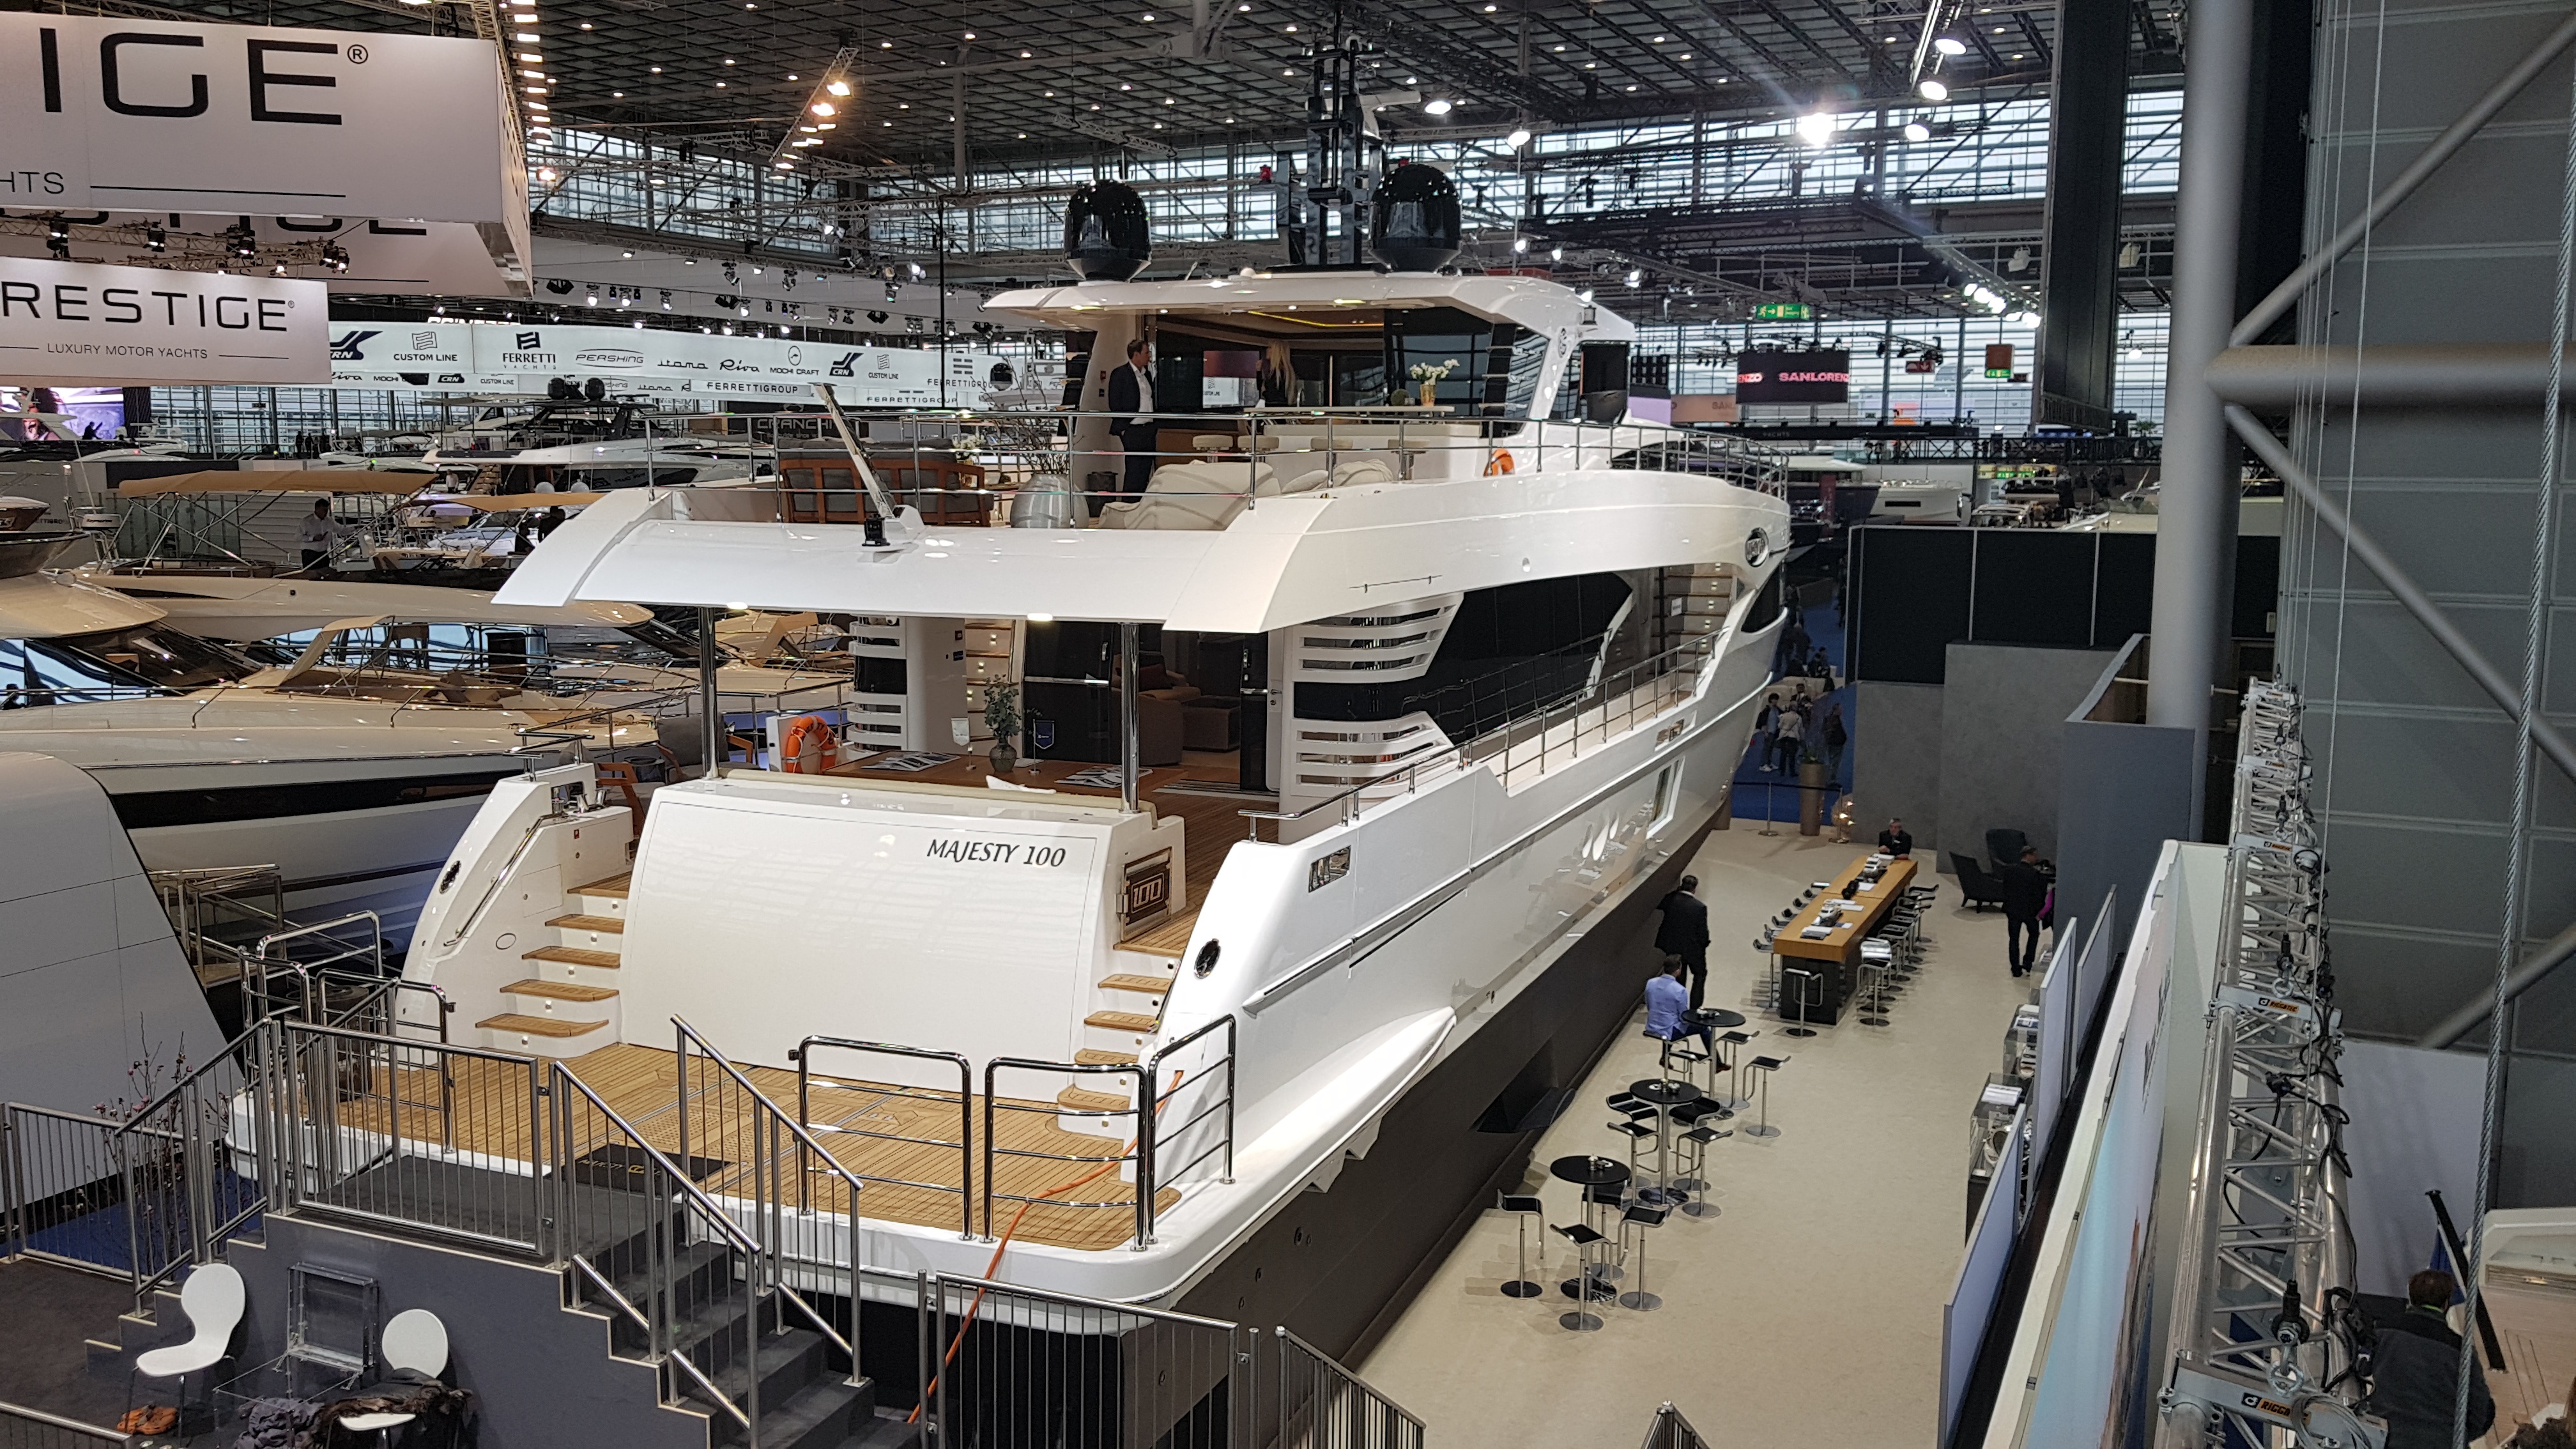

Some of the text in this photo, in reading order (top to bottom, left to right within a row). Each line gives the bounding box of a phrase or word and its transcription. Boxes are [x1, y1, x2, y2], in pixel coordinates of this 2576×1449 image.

[1, 280, 288, 332] RESTIGE
[47, 343, 208, 358] LUXURY MOTOR YACHTS
[330, 351, 354, 359] RN
[503, 353, 556, 364] FERRETTI
[576, 353, 644, 364] PERSHING
[719, 359, 760, 372] Riva
[707, 382, 799, 394] FERRETTIGROUP
[927, 378, 993, 388] FERETTIGROU
[757, 418, 832, 429] CRANCHI
[926, 839, 1066, 867] MAJESTY 100
[1133, 878, 1163, 908] 100
